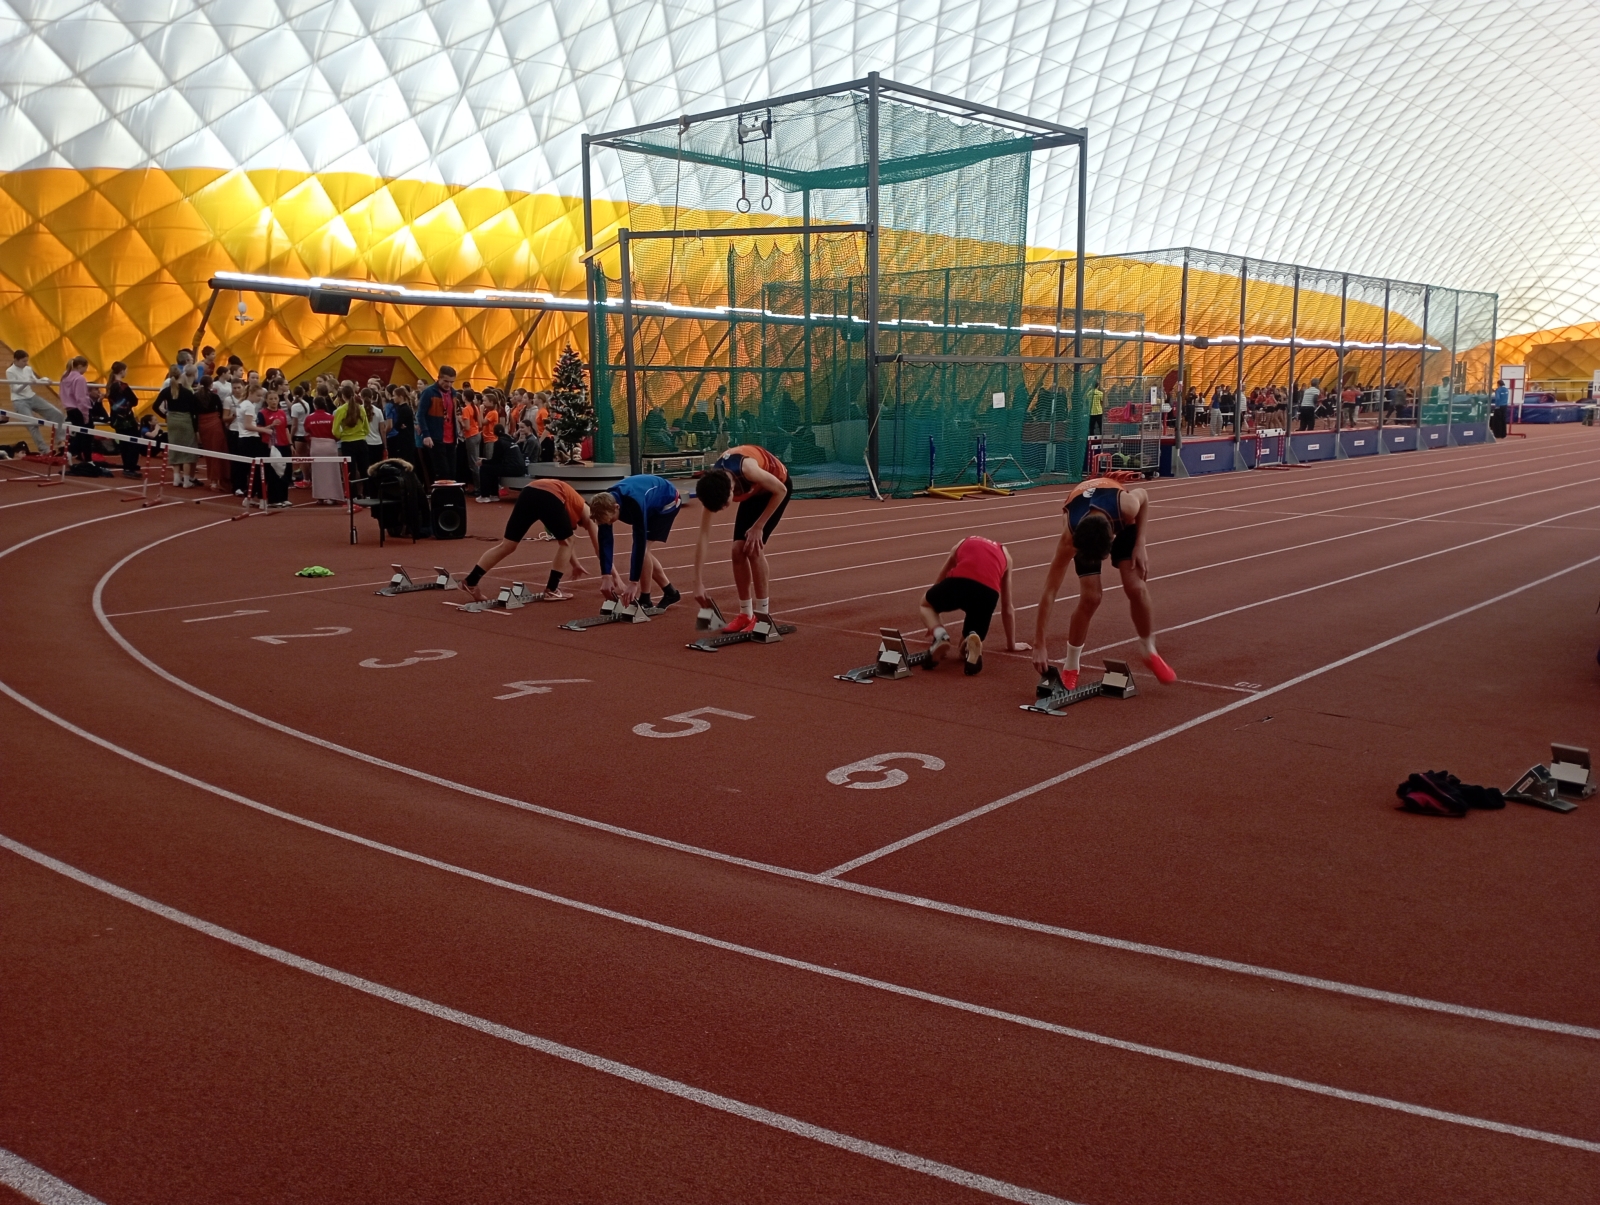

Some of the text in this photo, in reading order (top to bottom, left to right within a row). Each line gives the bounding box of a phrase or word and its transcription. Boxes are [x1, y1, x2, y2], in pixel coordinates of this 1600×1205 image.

[182, 610, 270, 623] 1
[251, 626, 353, 645] 2
[359, 649, 458, 669] 3
[493, 678, 594, 700] 4
[632, 706, 756, 738] 5
[826, 752, 946, 790] 6
